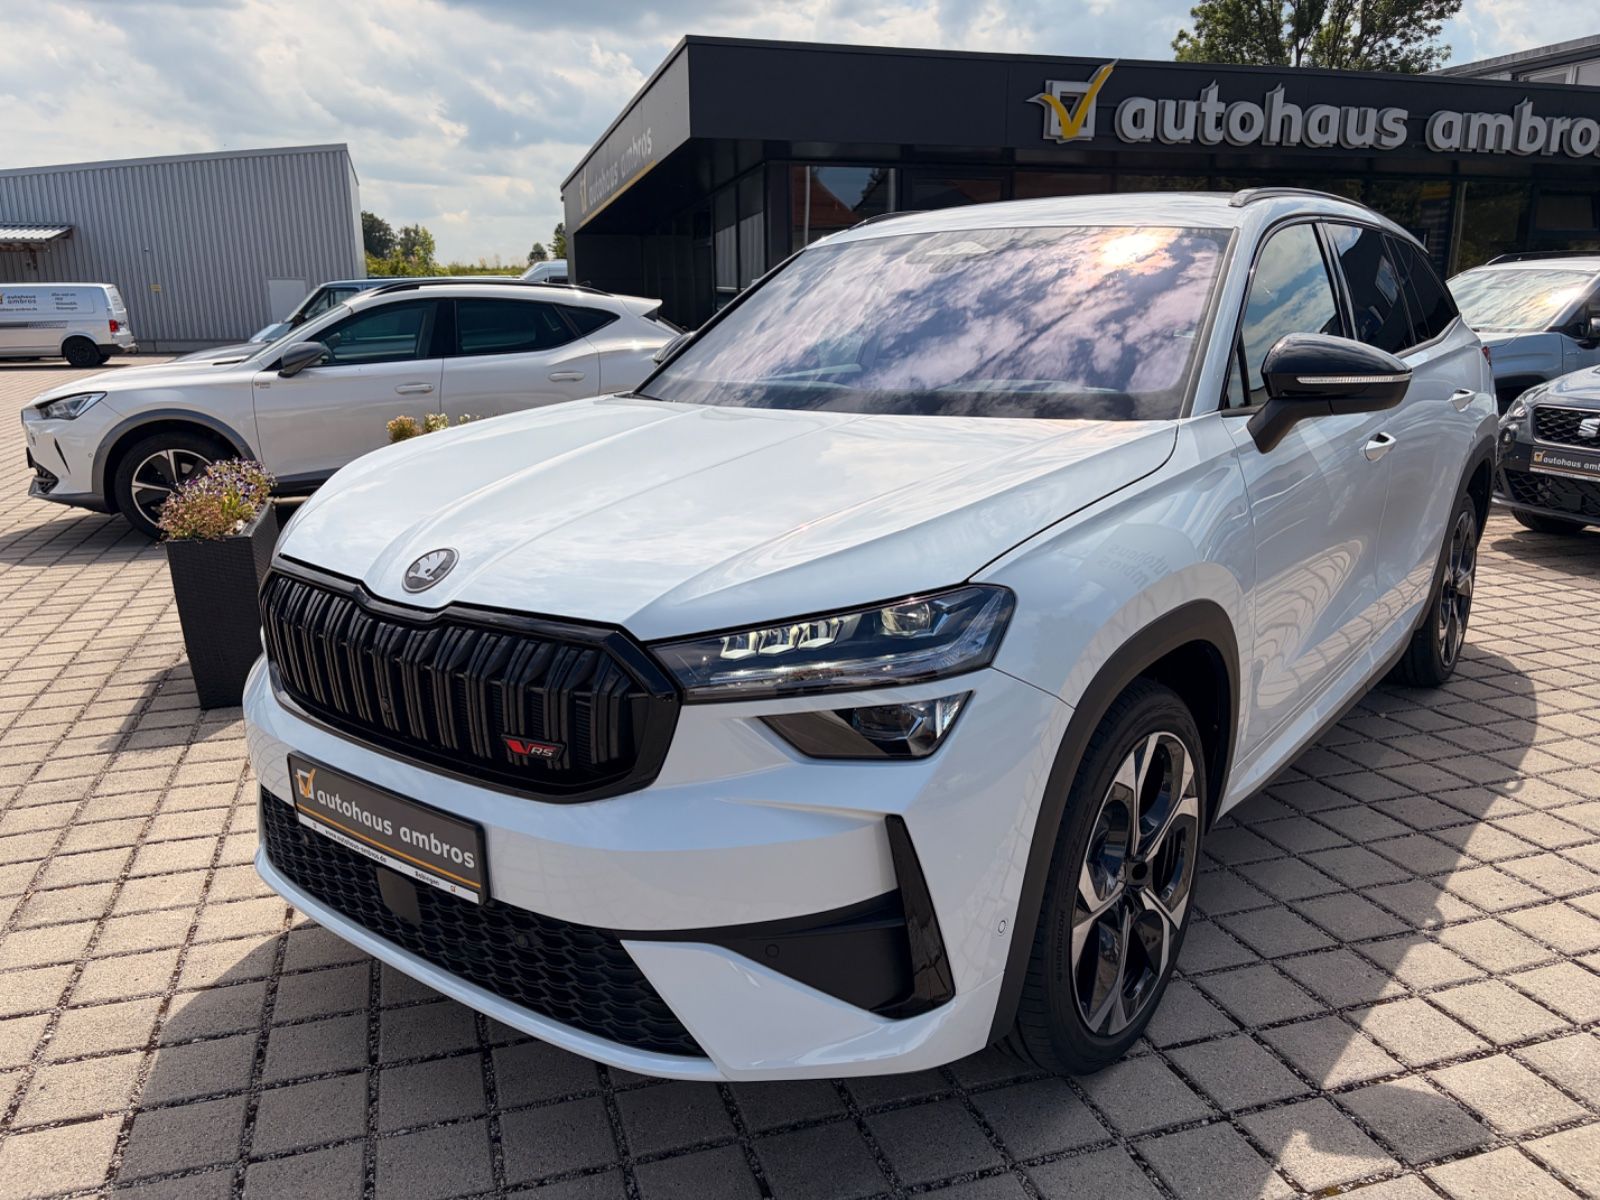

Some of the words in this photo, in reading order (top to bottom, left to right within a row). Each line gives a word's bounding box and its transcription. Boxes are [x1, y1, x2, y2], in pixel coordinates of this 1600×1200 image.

[1114, 79, 1408, 149] autohaus
[1425, 97, 1600, 158] ambro
[620, 127, 652, 178] ambros
[1543, 457, 1581, 468] autohaus
[316, 789, 393, 836] autohaus
[399, 826, 475, 869] ambros
